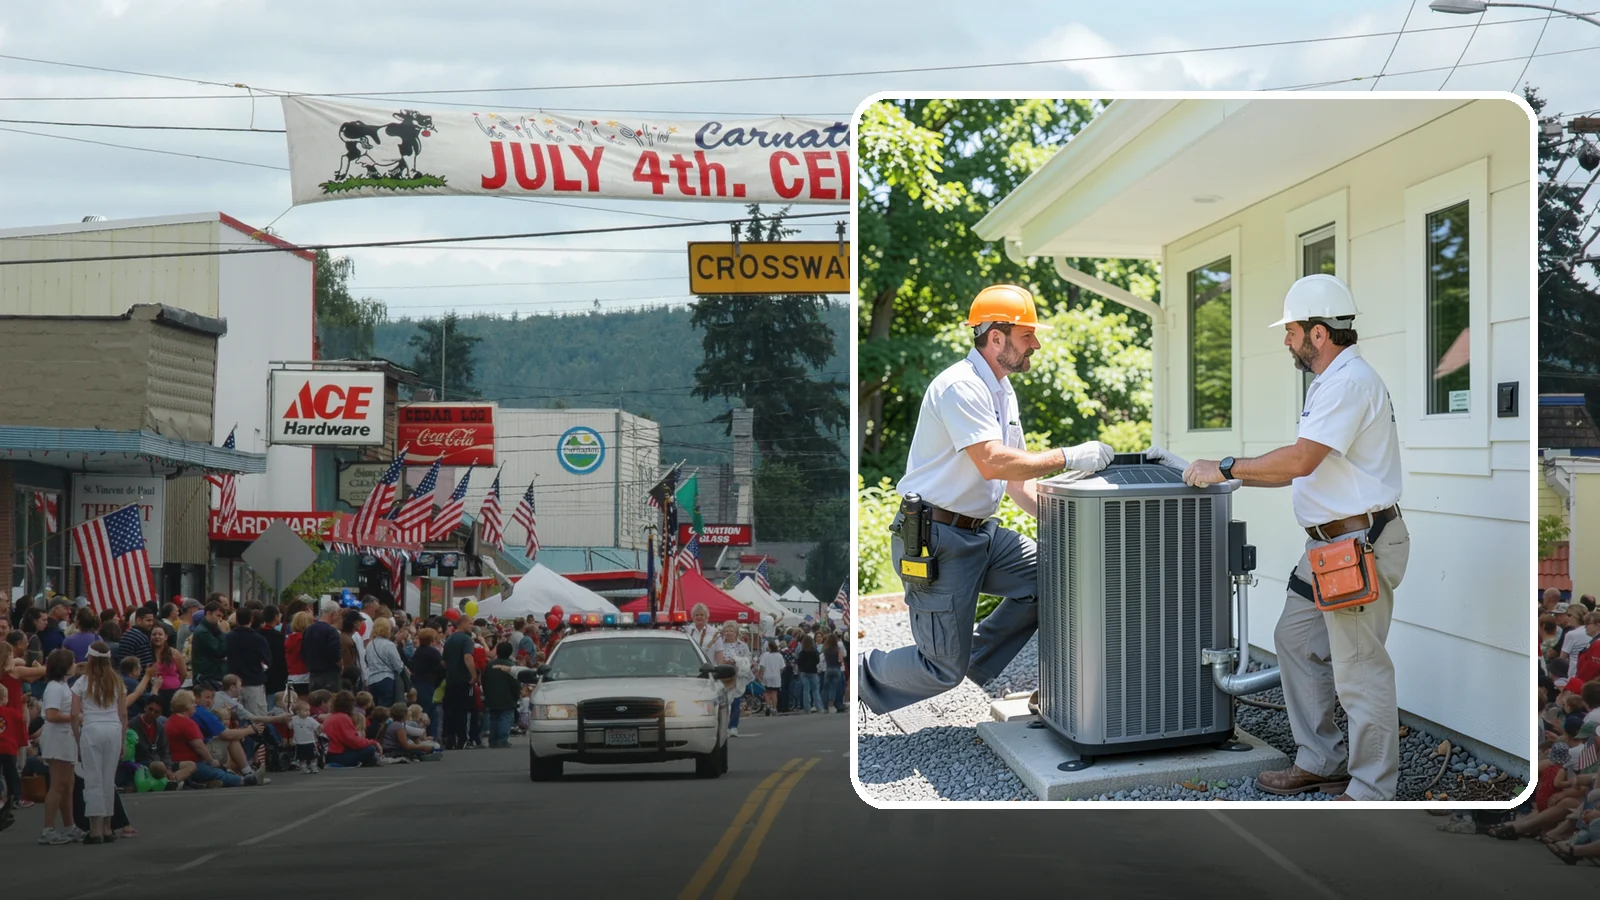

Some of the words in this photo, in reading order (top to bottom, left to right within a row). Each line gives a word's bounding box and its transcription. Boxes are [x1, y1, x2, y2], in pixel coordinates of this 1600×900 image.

[695, 121, 850, 150] Carnat
[481, 141, 605, 192] JULY
[632, 149, 746, 197] 4th.
[697, 254, 850, 280] CROSSWA
[282, 380, 373, 420] ACE
[405, 409, 452, 422] CEDAR
[461, 409, 486, 421] LOG
[283, 421, 371, 436] Hardware
[416, 428, 477, 447] Coca-Cola
[353, 467, 386, 482] Simpl
[83, 484, 93, 494] St.
[95, 484, 124, 495] Vincent
[126, 485, 136, 495] de
[137, 486, 155, 495] Paul
[81, 503, 154, 522] THT
[212, 516, 331, 535] HARDARE
[688, 526, 742, 535] CRNATION
[699, 535, 731, 543] GLASS
